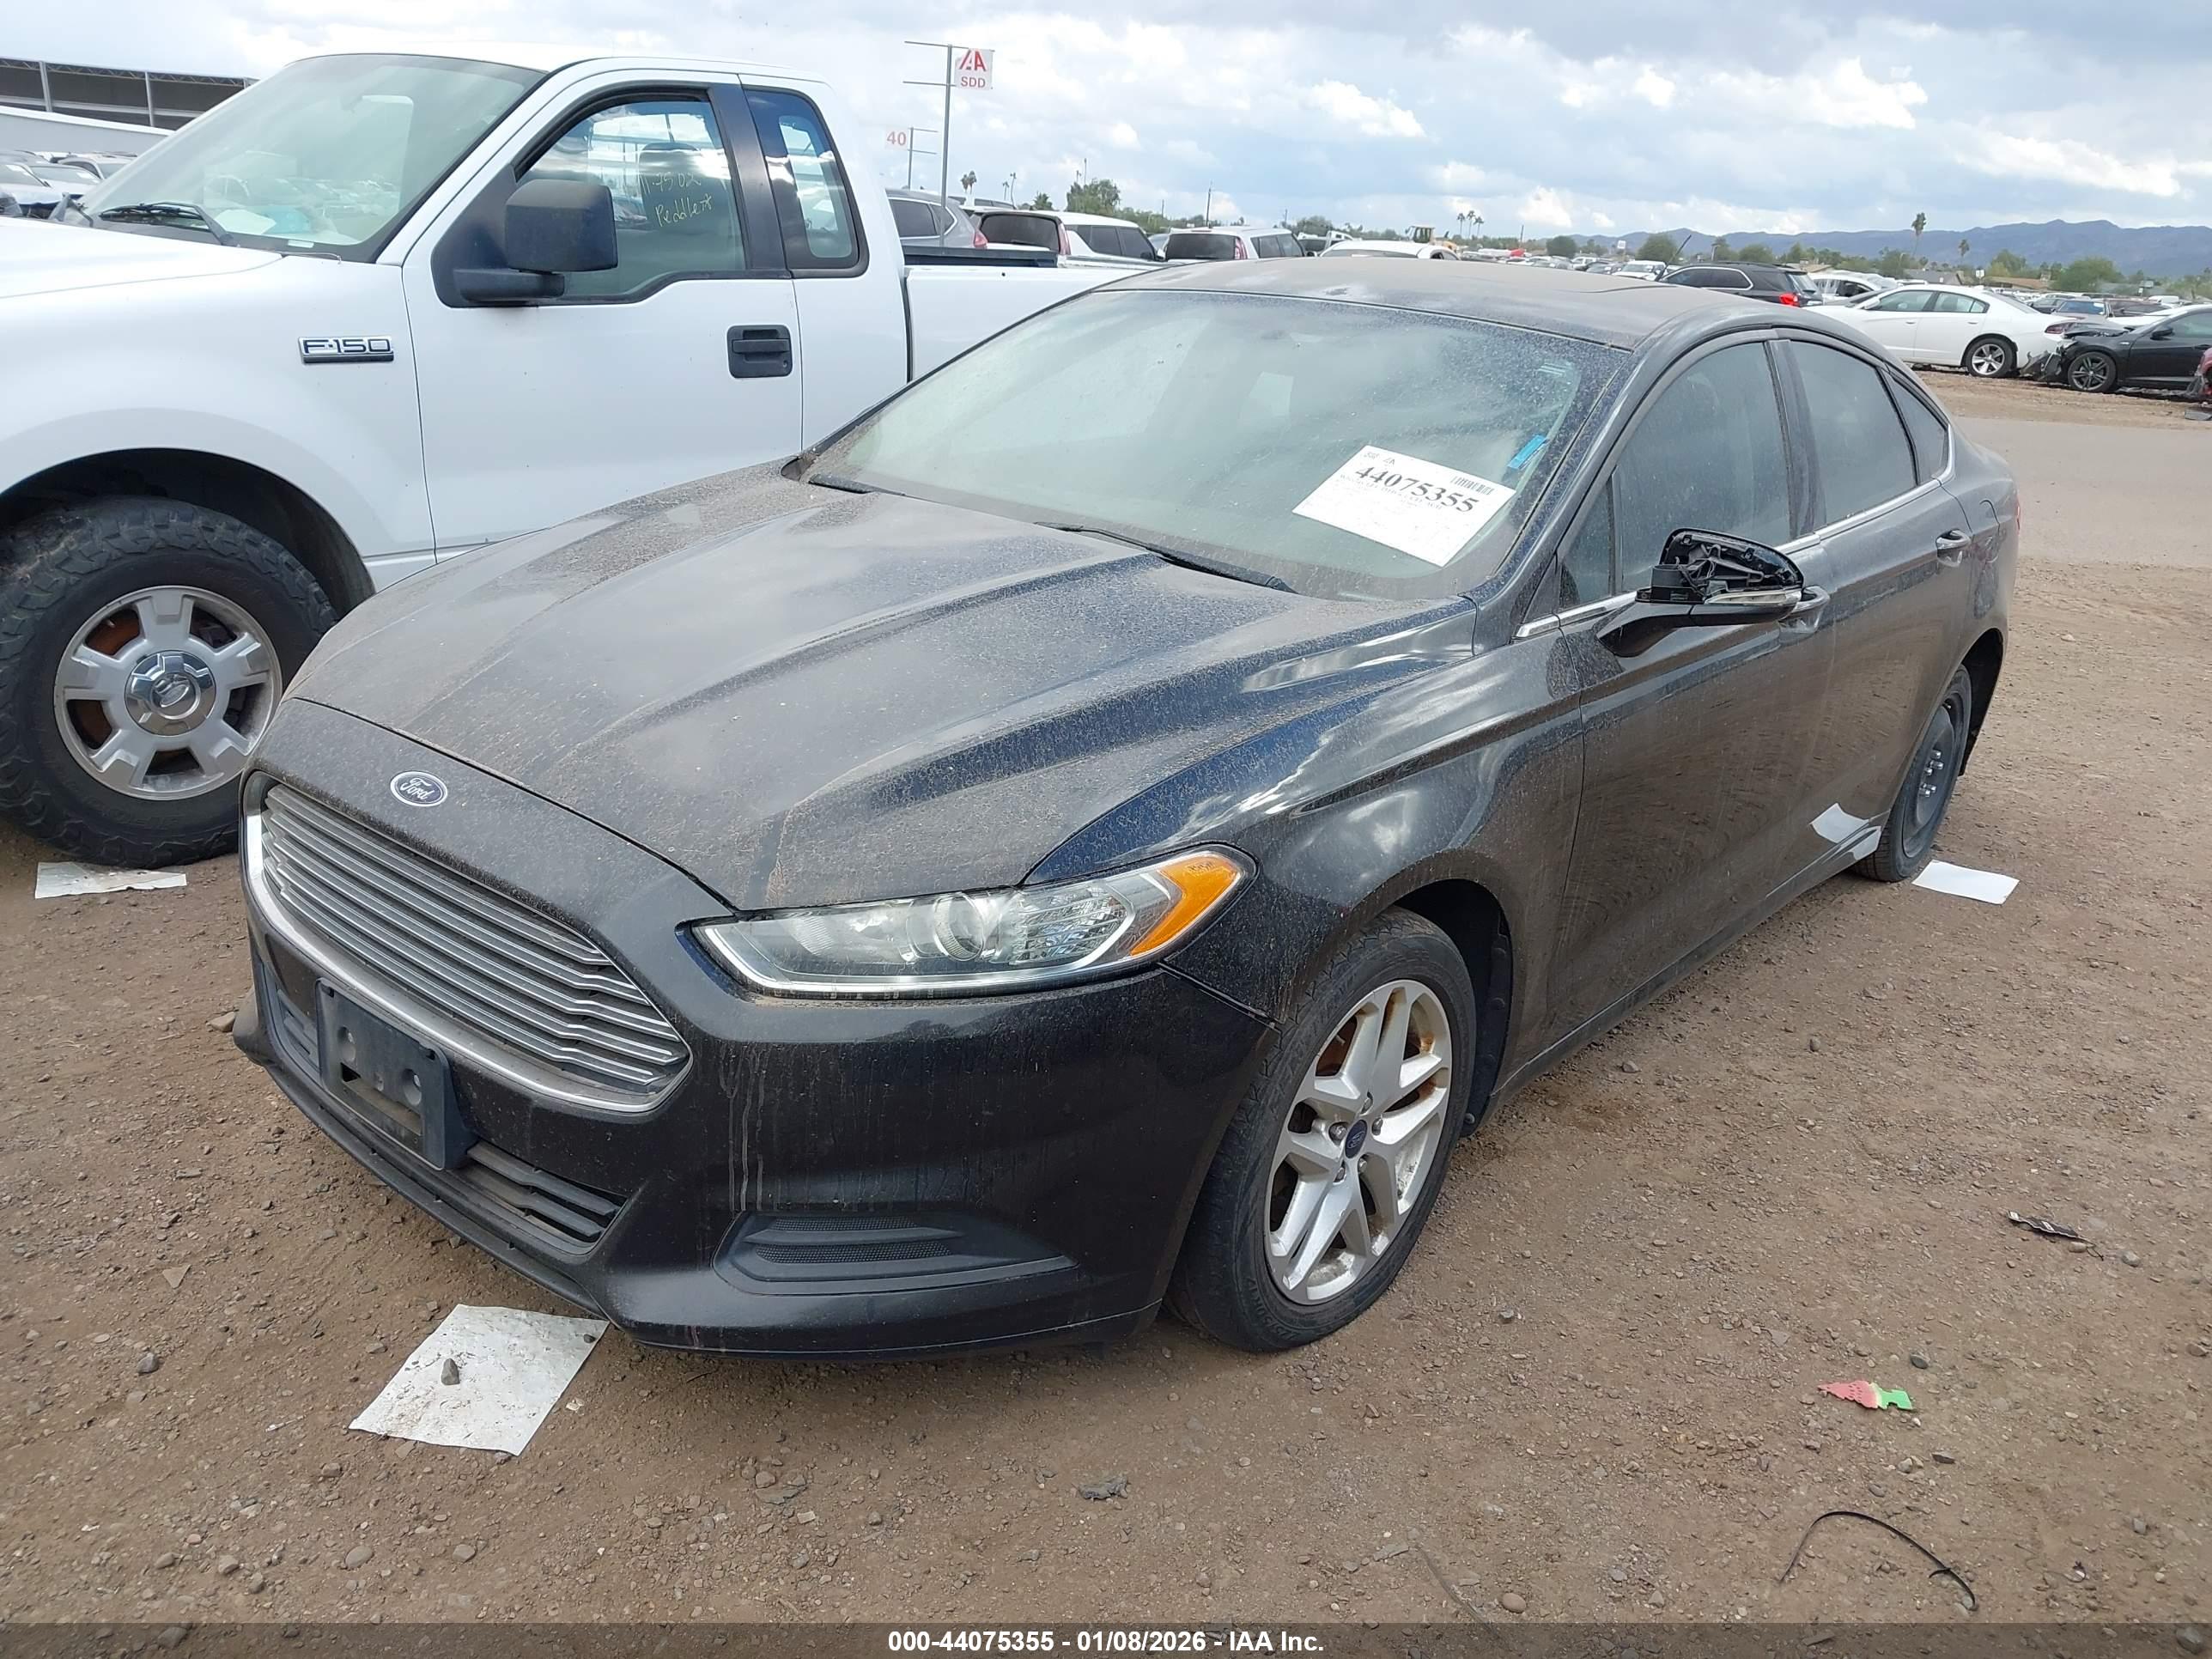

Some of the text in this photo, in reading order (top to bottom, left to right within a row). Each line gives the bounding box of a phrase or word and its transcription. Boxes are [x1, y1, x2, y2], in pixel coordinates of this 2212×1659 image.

[960, 76, 986, 88] SDD
[886, 131, 907, 146] 40
[1355, 466, 1480, 513] 44075355
[399, 777, 435, 800] Ford
